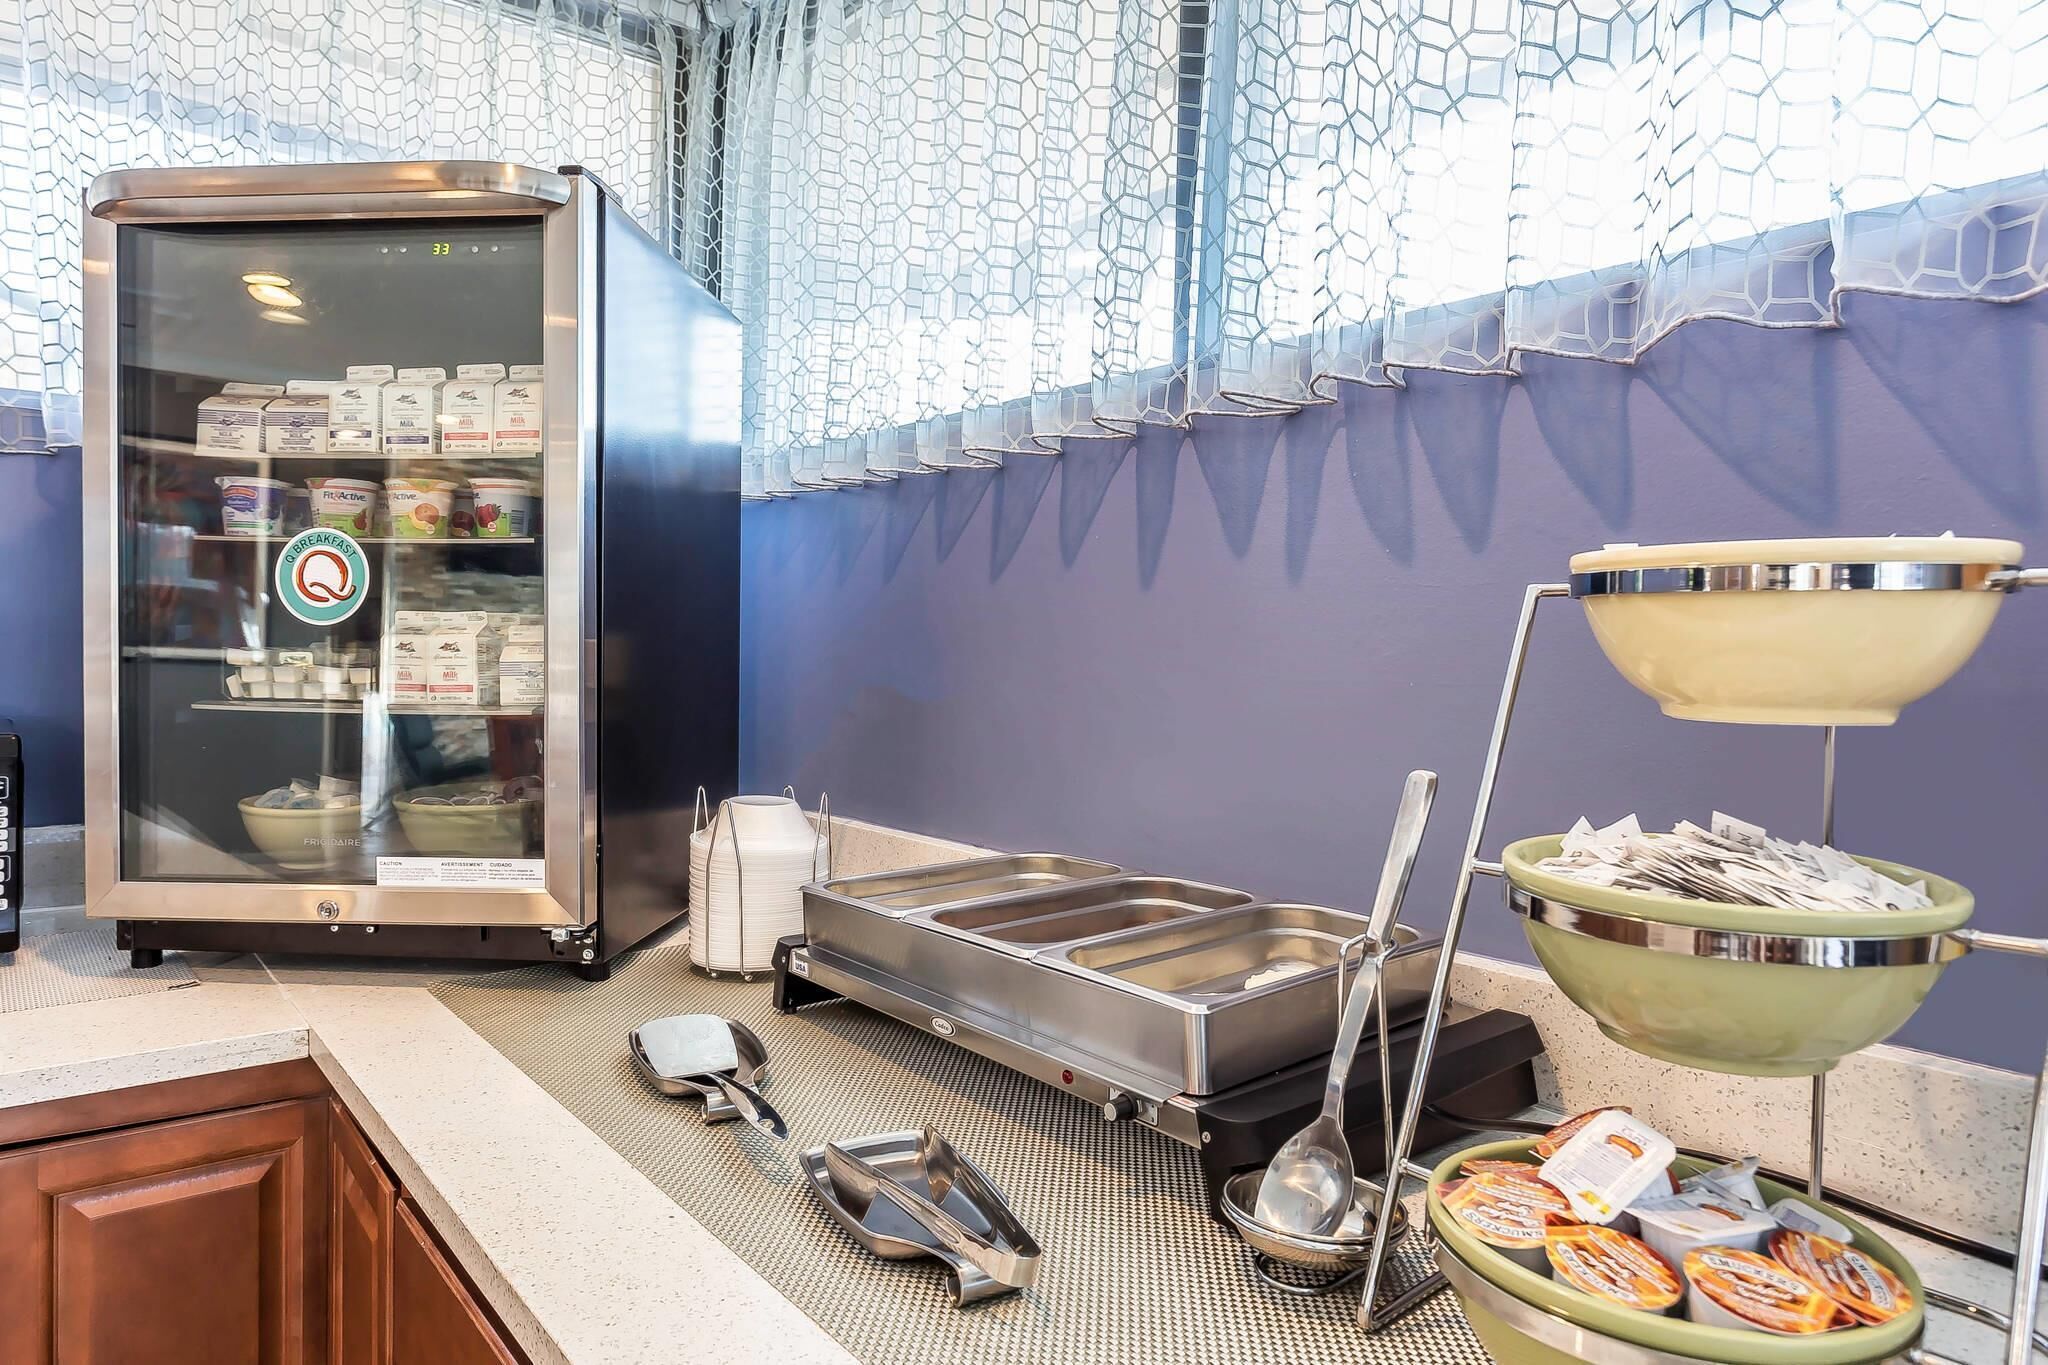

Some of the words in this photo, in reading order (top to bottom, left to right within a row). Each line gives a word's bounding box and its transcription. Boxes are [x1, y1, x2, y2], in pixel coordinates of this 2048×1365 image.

[432, 243, 450, 255] 33
[285, 554, 296, 563] Q
[293, 534, 357, 558] BREAKFAST
[295, 550, 357, 602] Q
[304, 838, 361, 847] FRIGIDAIRE
[795, 962, 806, 972] USA
